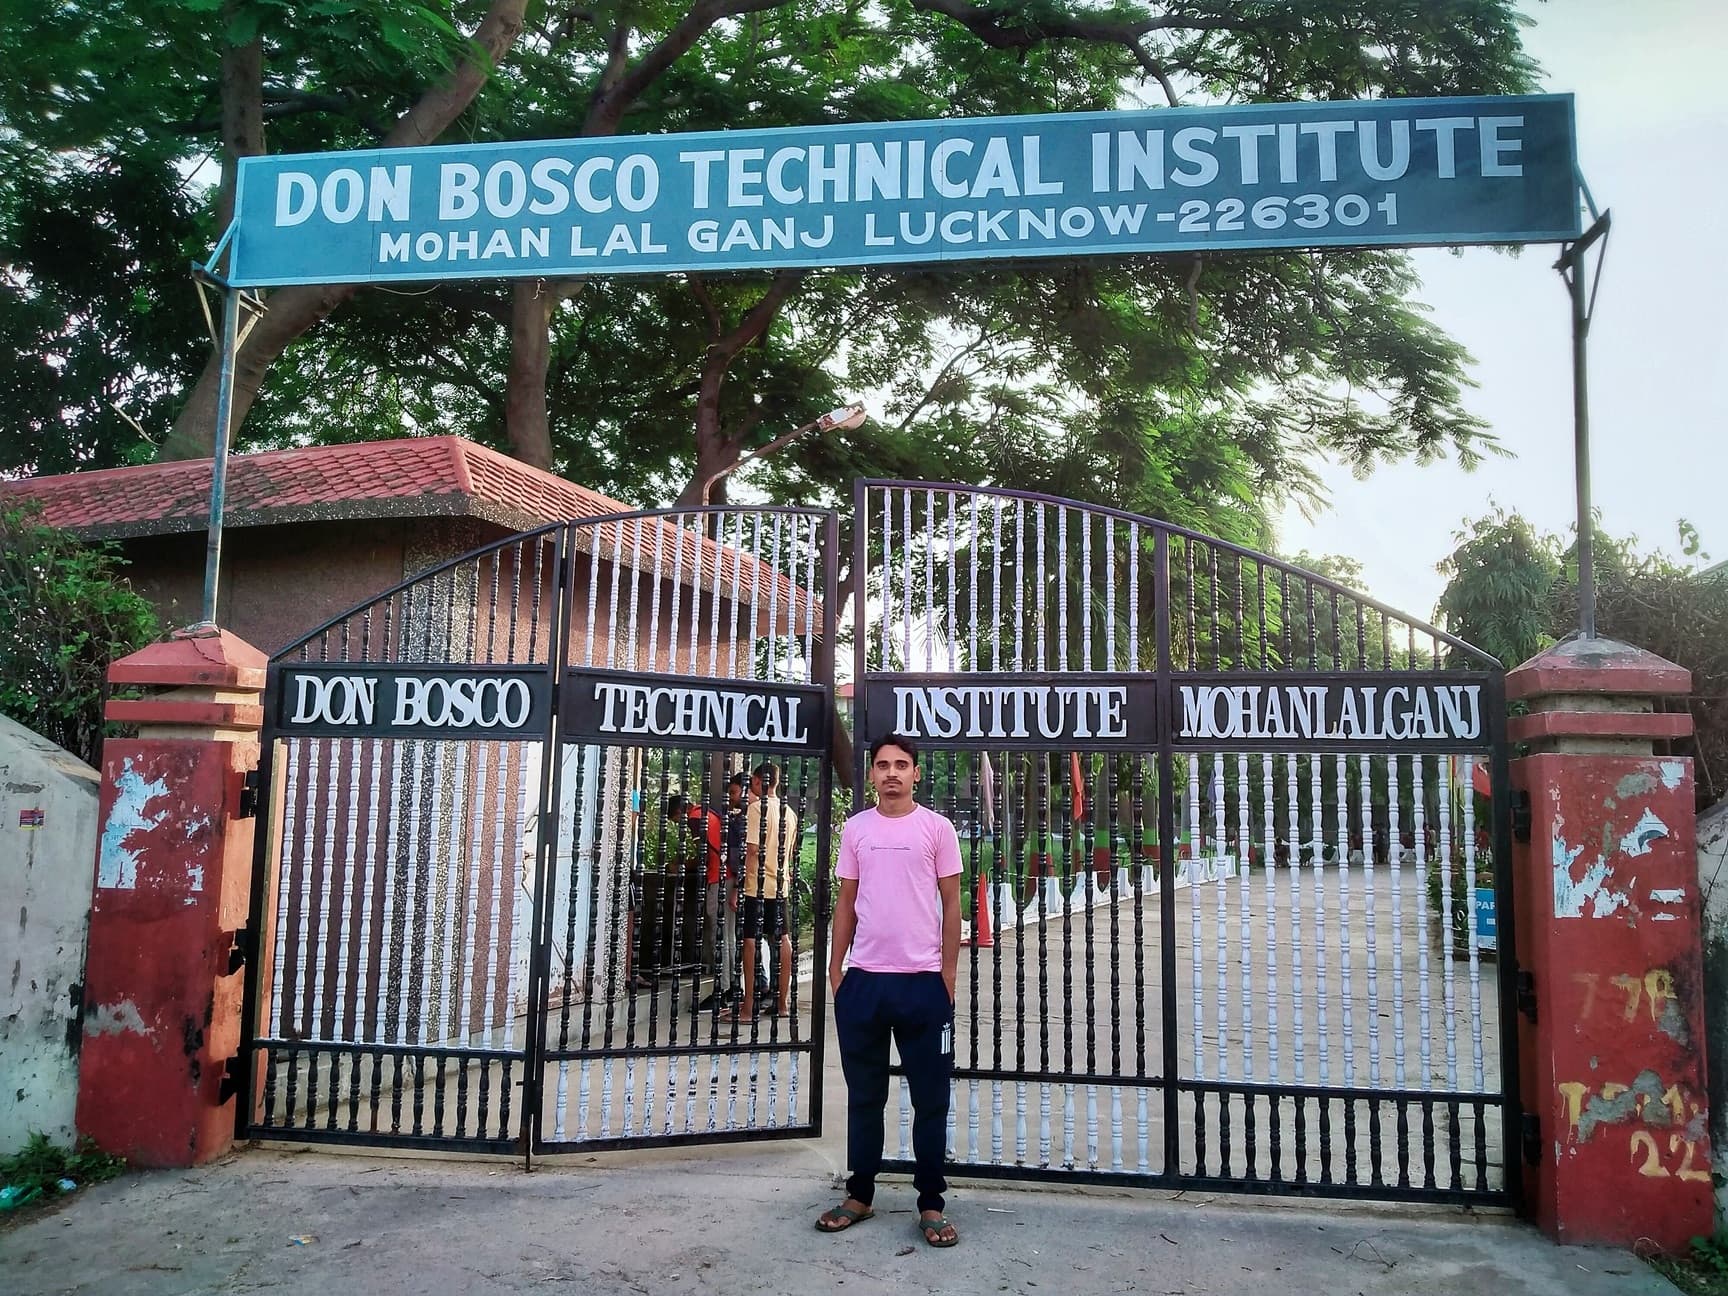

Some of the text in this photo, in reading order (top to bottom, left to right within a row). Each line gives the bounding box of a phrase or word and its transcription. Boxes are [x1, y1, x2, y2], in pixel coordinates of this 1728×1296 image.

[275, 116, 1525, 227] DON BOSCO TECHNICAL INSTITUTE
[379, 226, 550, 263] MOHAN
[570, 222, 668, 257] LAL
[687, 214, 835, 253] GANJ
[291, 674, 532, 728] DON BOSCO
[594, 682, 808, 744] TECHNICAL
[893, 686, 1127, 738] INSTITUTE
[1179, 684, 1481, 740] MOHANLALGANJ
